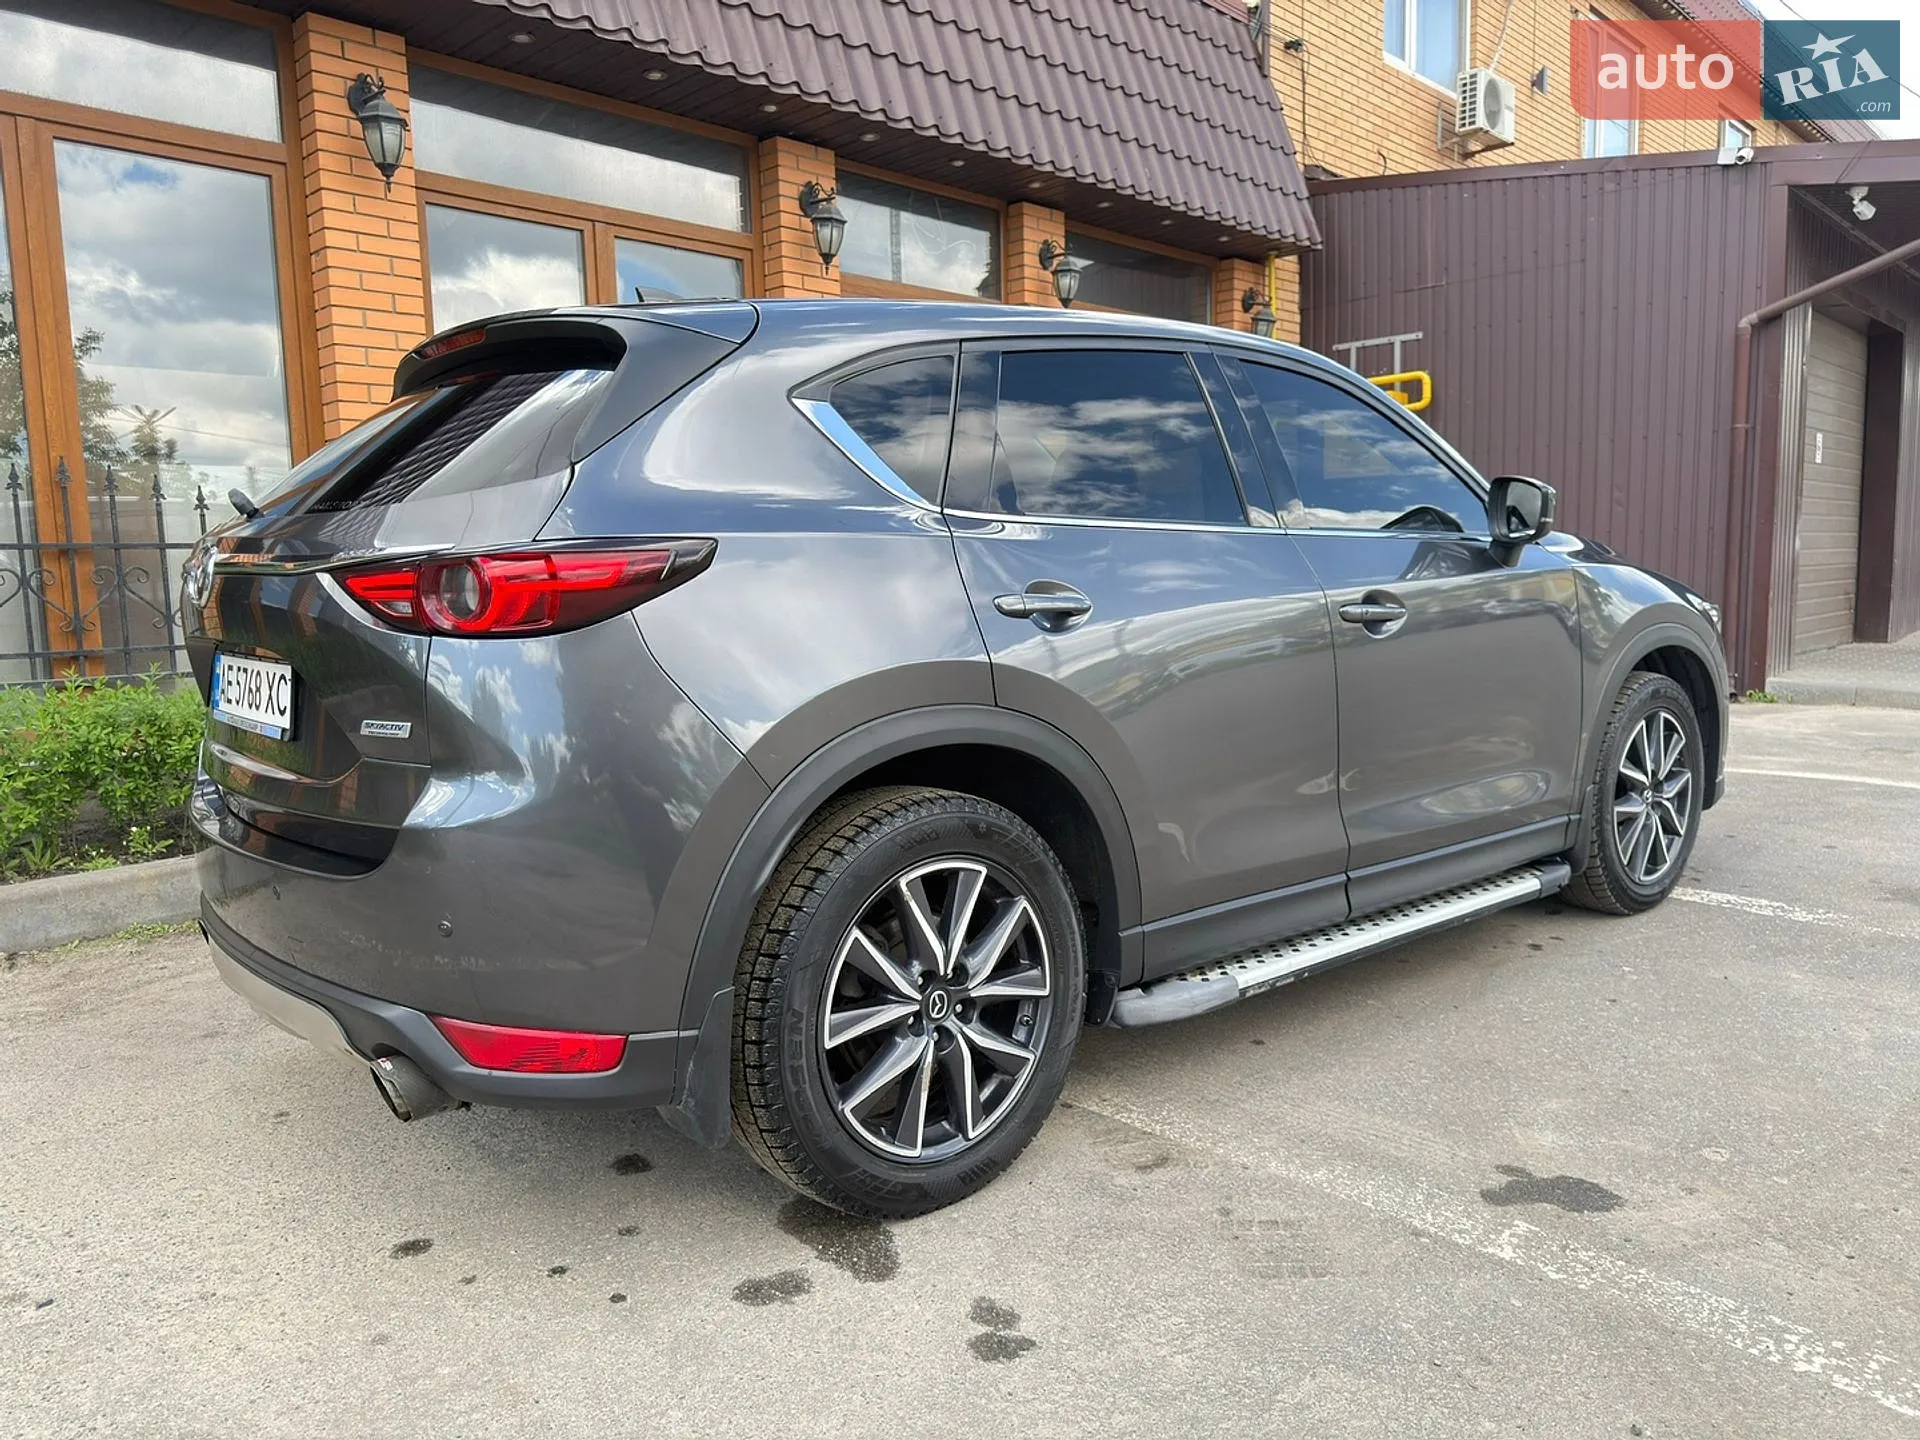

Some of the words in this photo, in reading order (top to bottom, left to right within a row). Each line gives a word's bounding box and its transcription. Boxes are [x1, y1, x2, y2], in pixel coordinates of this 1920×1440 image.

[221, 664, 234, 705] AE
[235, 666, 262, 711] 5768
[265, 670, 288, 717] XC
